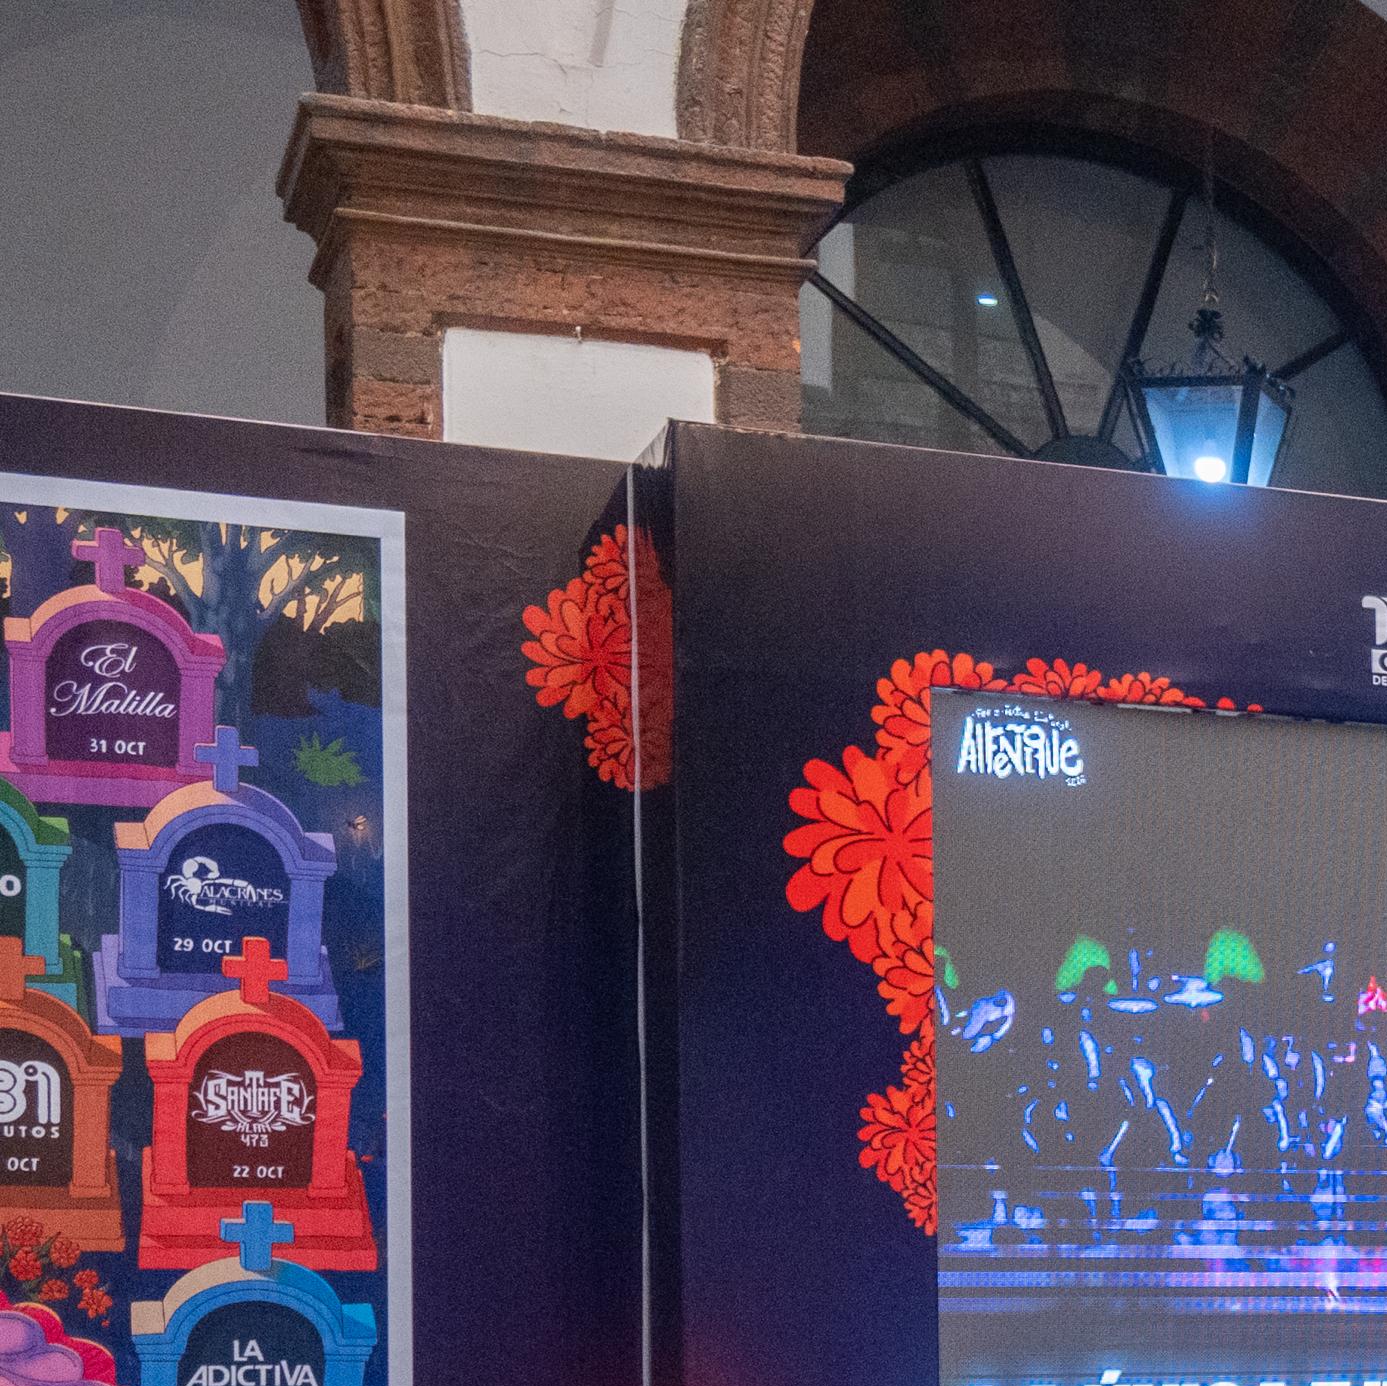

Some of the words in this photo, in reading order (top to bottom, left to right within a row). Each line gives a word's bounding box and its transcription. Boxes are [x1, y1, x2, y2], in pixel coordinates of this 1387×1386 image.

[81, 642, 137, 677] El
[50, 680, 177, 719] Malilla
[89, 738, 107, 753] 31
[114, 740, 146, 756] OCT
[200, 884, 284, 902] ALACRANES
[173, 937, 194, 952] 29
[201, 938, 233, 953] OCT
[7, 1157, 40, 1172] OCT
[232, 1165, 250, 1178] 22
[256, 1165, 285, 1180] OCT
[233, 1339, 263, 1362] LA
